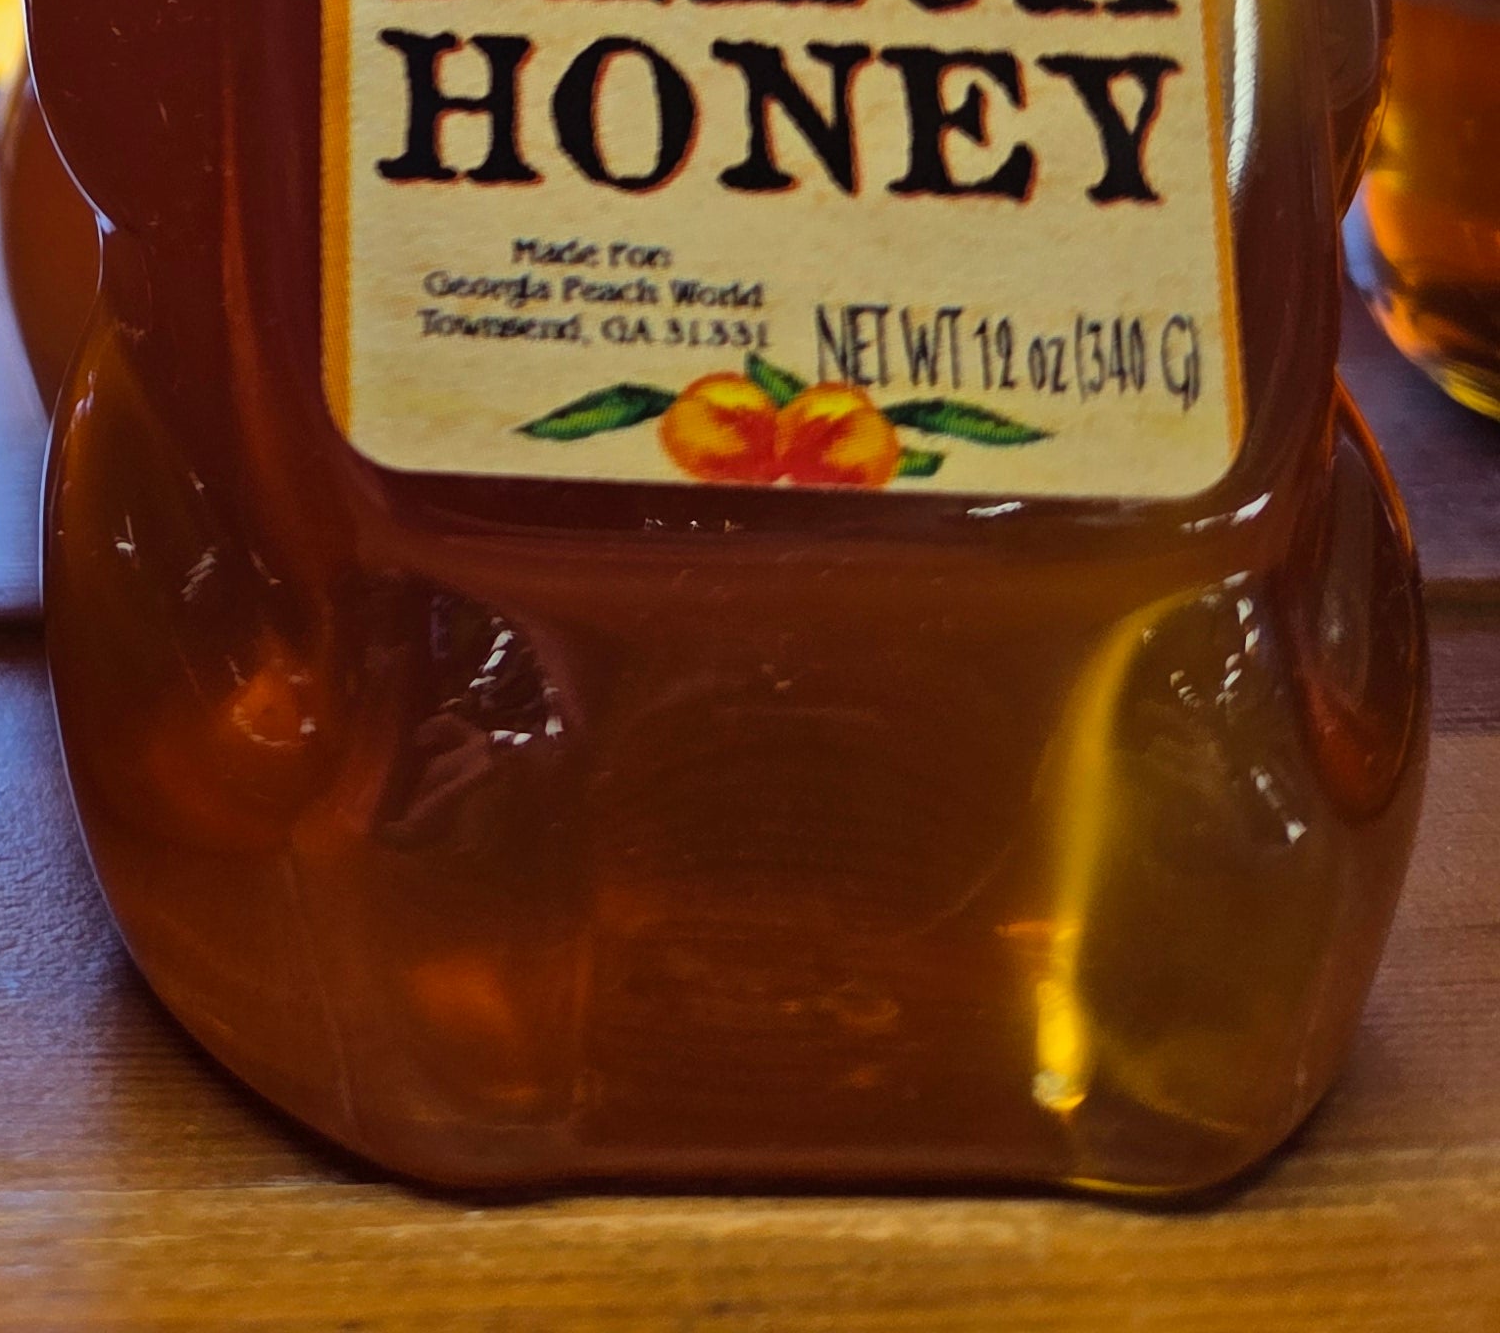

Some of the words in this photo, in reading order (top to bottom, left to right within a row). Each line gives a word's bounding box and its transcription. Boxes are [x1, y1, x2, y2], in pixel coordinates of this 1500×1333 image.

[376, 28, 1184, 204] HONEY
[511, 237, 599, 267] Made
[424, 270, 551, 308] Georgia
[561, 275, 660, 306] Peach
[668, 279, 765, 309] World
[418, 307, 590, 346] Townsend,
[601, 315, 652, 345] GA
[662, 318, 770, 349] 31331
[815, 303, 890, 387] NET
[900, 305, 962, 389] WT
[974, 315, 1016, 390] 12
[1027, 335, 1067, 394] oz
[1075, 311, 1146, 403] (340
[1160, 311, 1201, 413] G)
